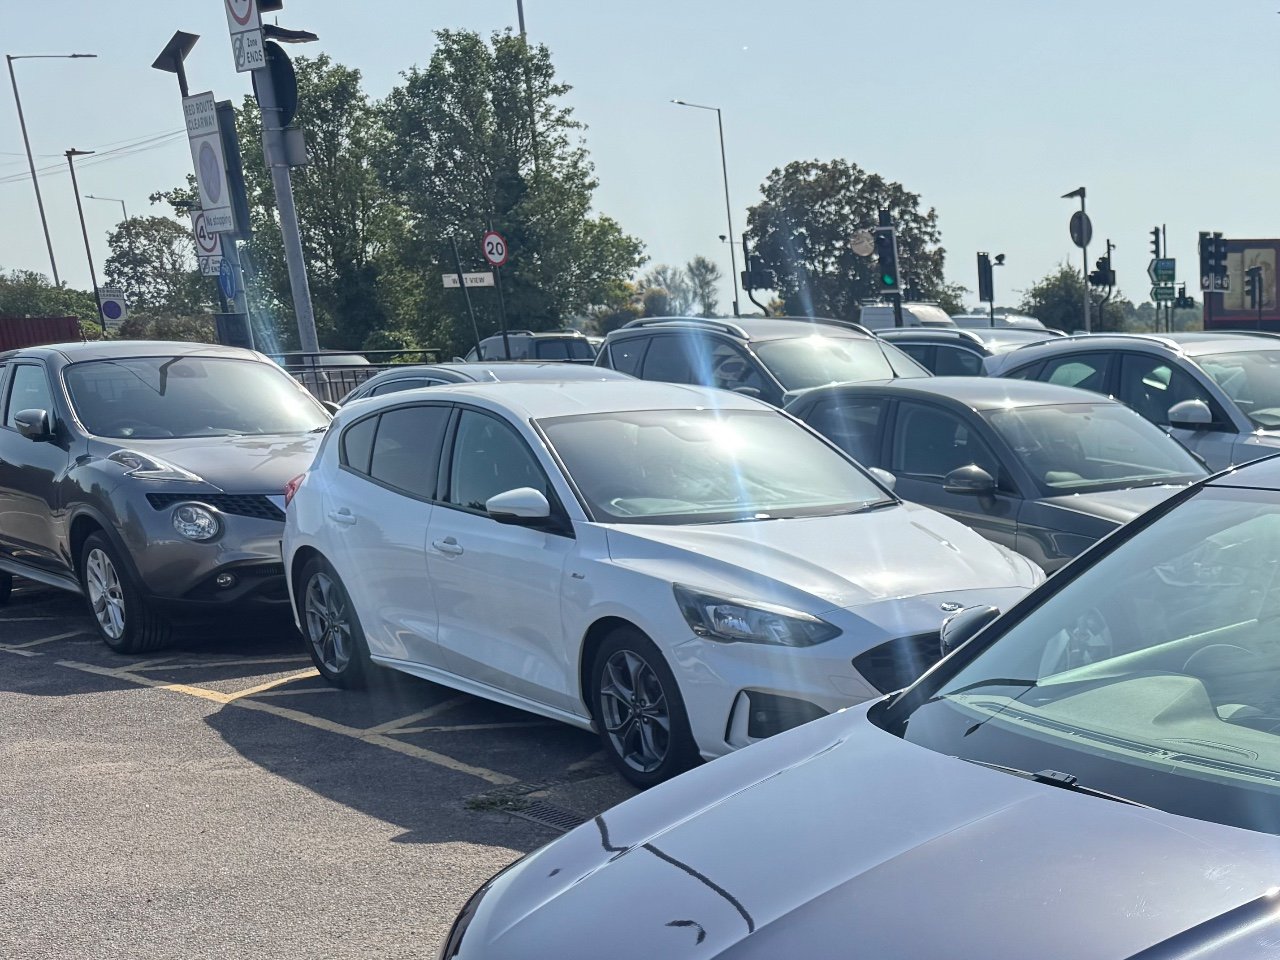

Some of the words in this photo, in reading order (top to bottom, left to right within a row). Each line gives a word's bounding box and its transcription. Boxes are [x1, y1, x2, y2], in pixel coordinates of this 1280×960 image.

[246, 50, 262, 63] ENDS
[184, 104, 195, 116] RED
[196, 100, 214, 114] ROUTE
[187, 114, 215, 131] CLEARWAY
[205, 215, 213, 226] No
[213, 215, 232, 226] stopping
[486, 241, 504, 256] 20
